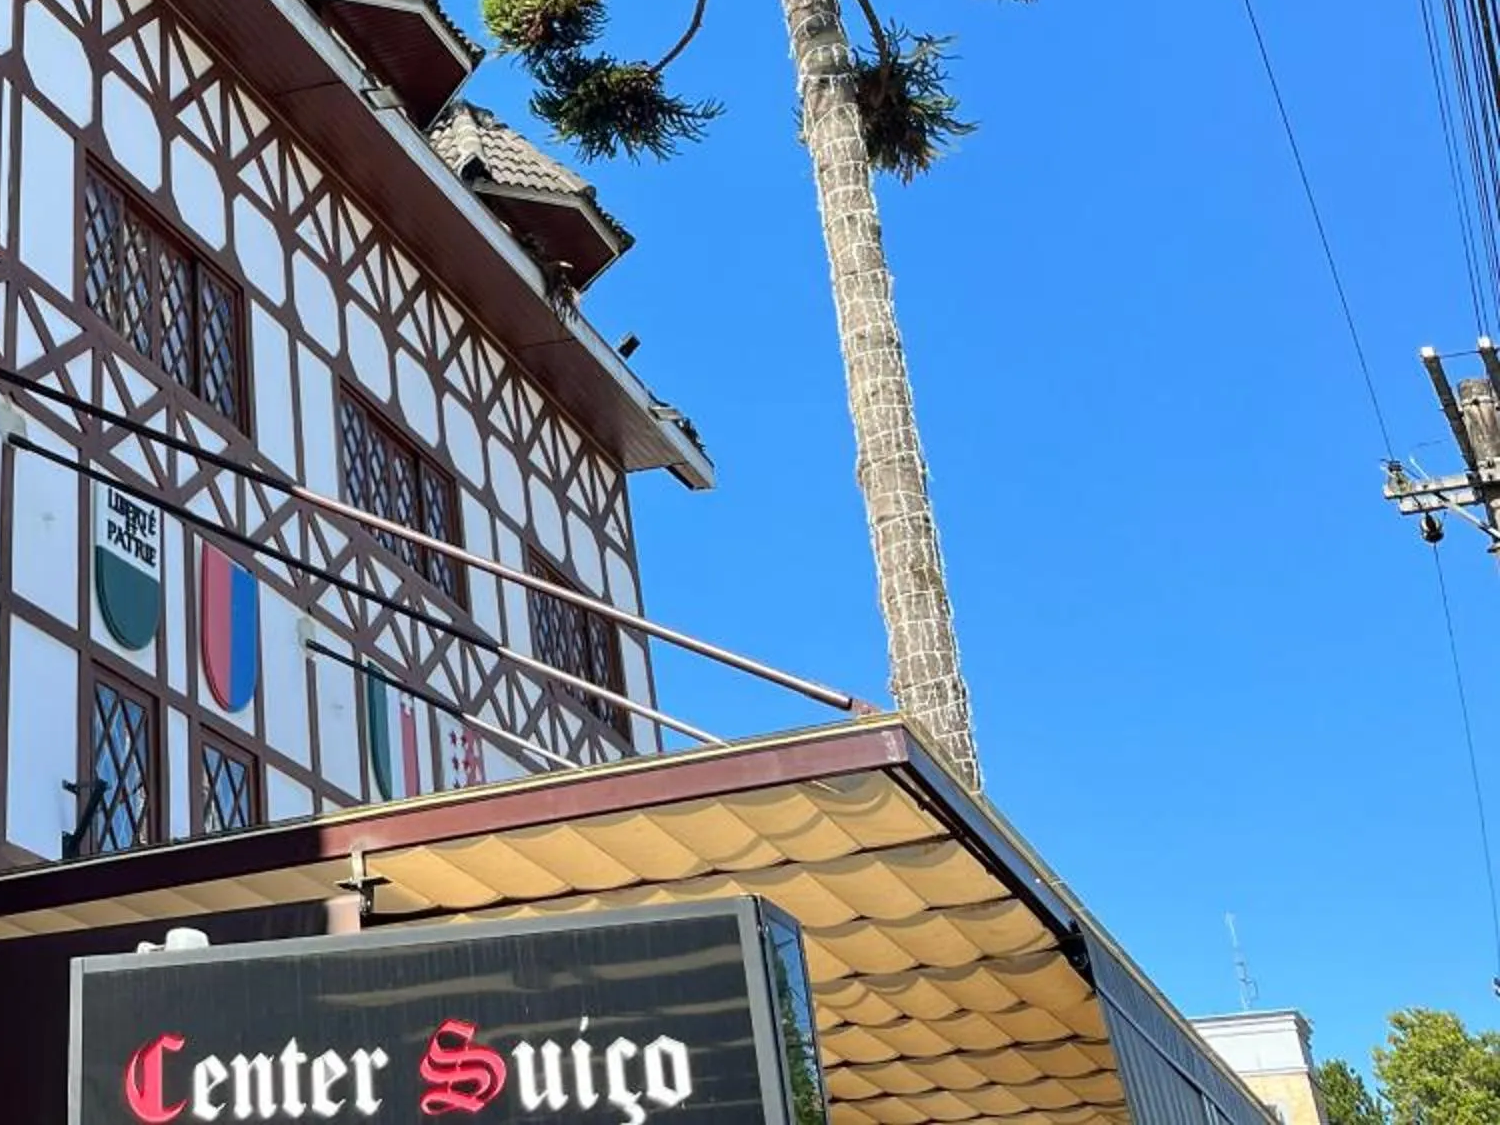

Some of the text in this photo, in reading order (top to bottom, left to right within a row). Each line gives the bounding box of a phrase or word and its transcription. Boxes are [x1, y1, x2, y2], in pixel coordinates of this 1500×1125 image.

[107, 520, 156, 567] PATRIE
[124, 1016, 694, 1125] Center Suiço
